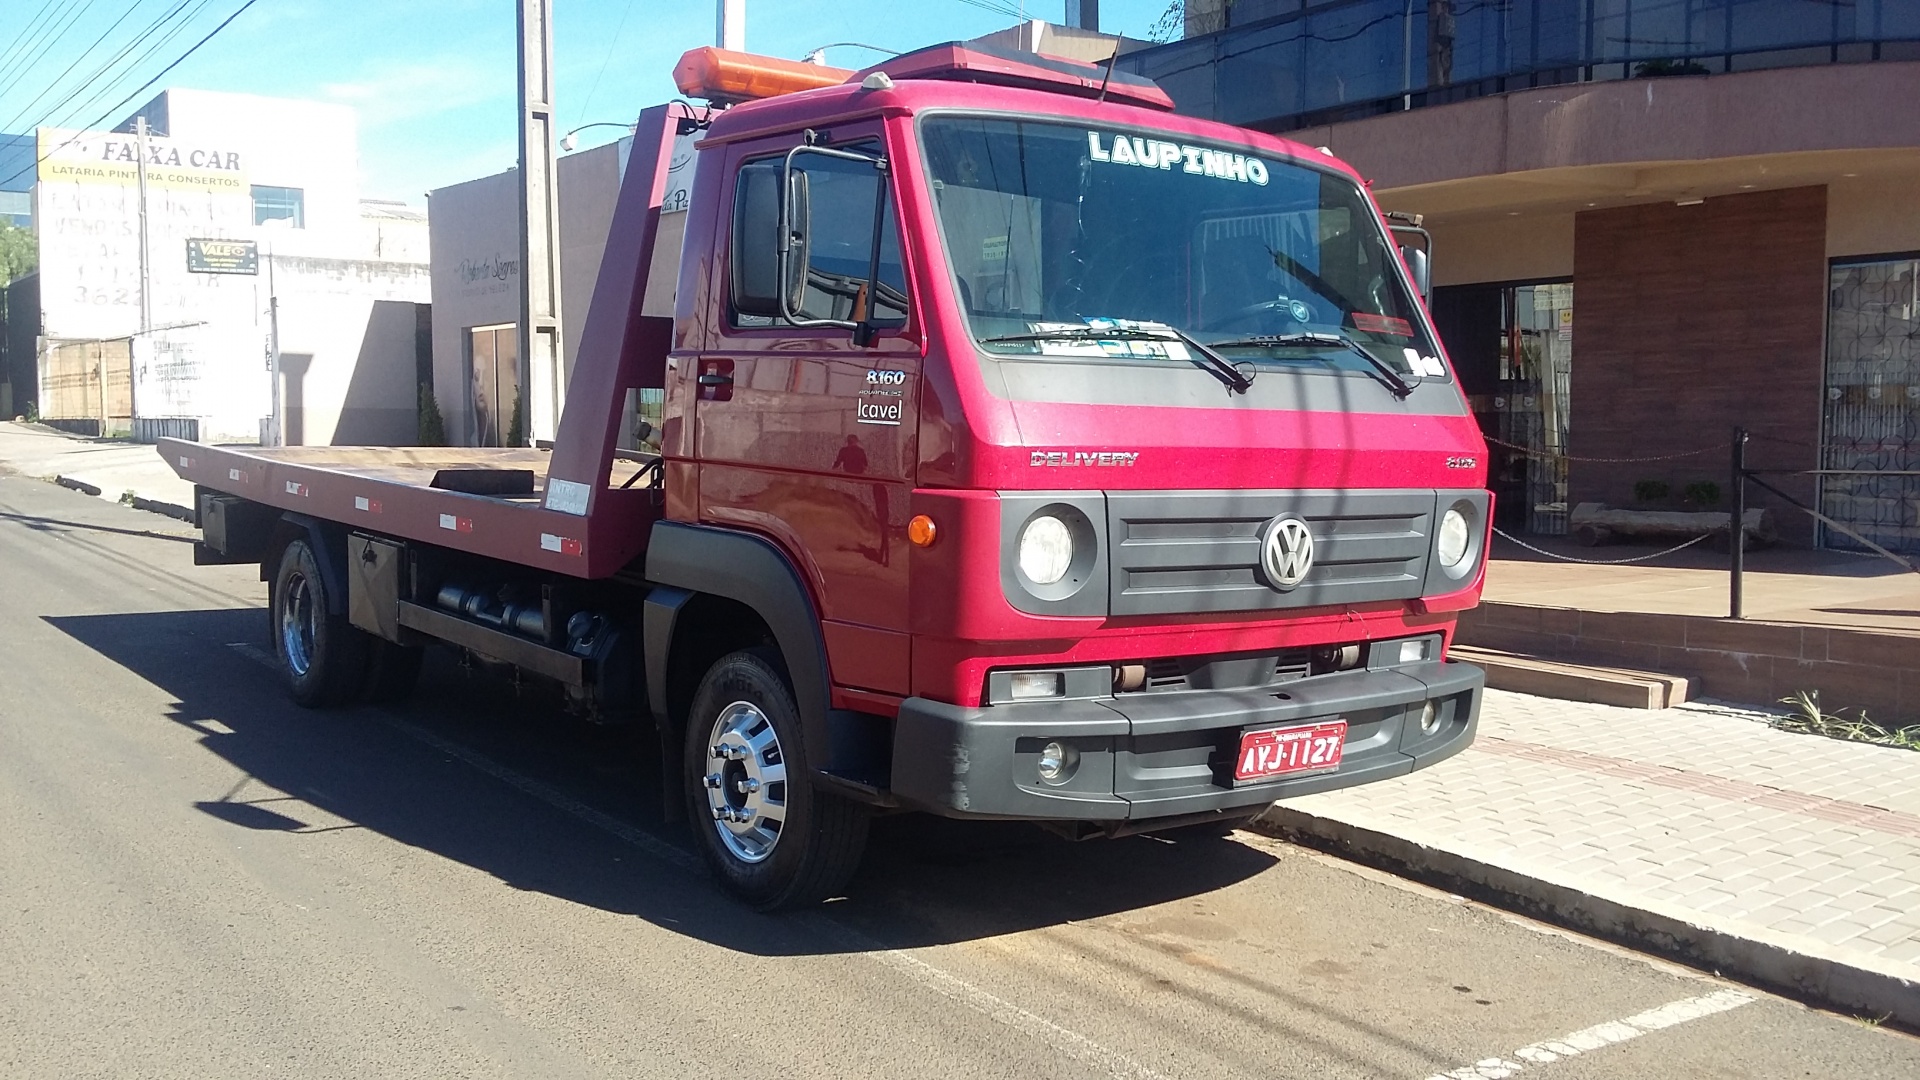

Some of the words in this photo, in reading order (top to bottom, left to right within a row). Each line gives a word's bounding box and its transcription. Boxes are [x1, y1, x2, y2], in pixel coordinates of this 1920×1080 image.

[102, 142, 182, 166] FAXA
[190, 149, 240, 171] CAR
[1088, 131, 1269, 186] LAUPINHO
[52, 165, 105, 178] LATARIA
[109, 169, 163, 181] PINTRA
[168, 174, 240, 187] CONSERTOS
[1029, 450, 1140, 467] DELIVERY
